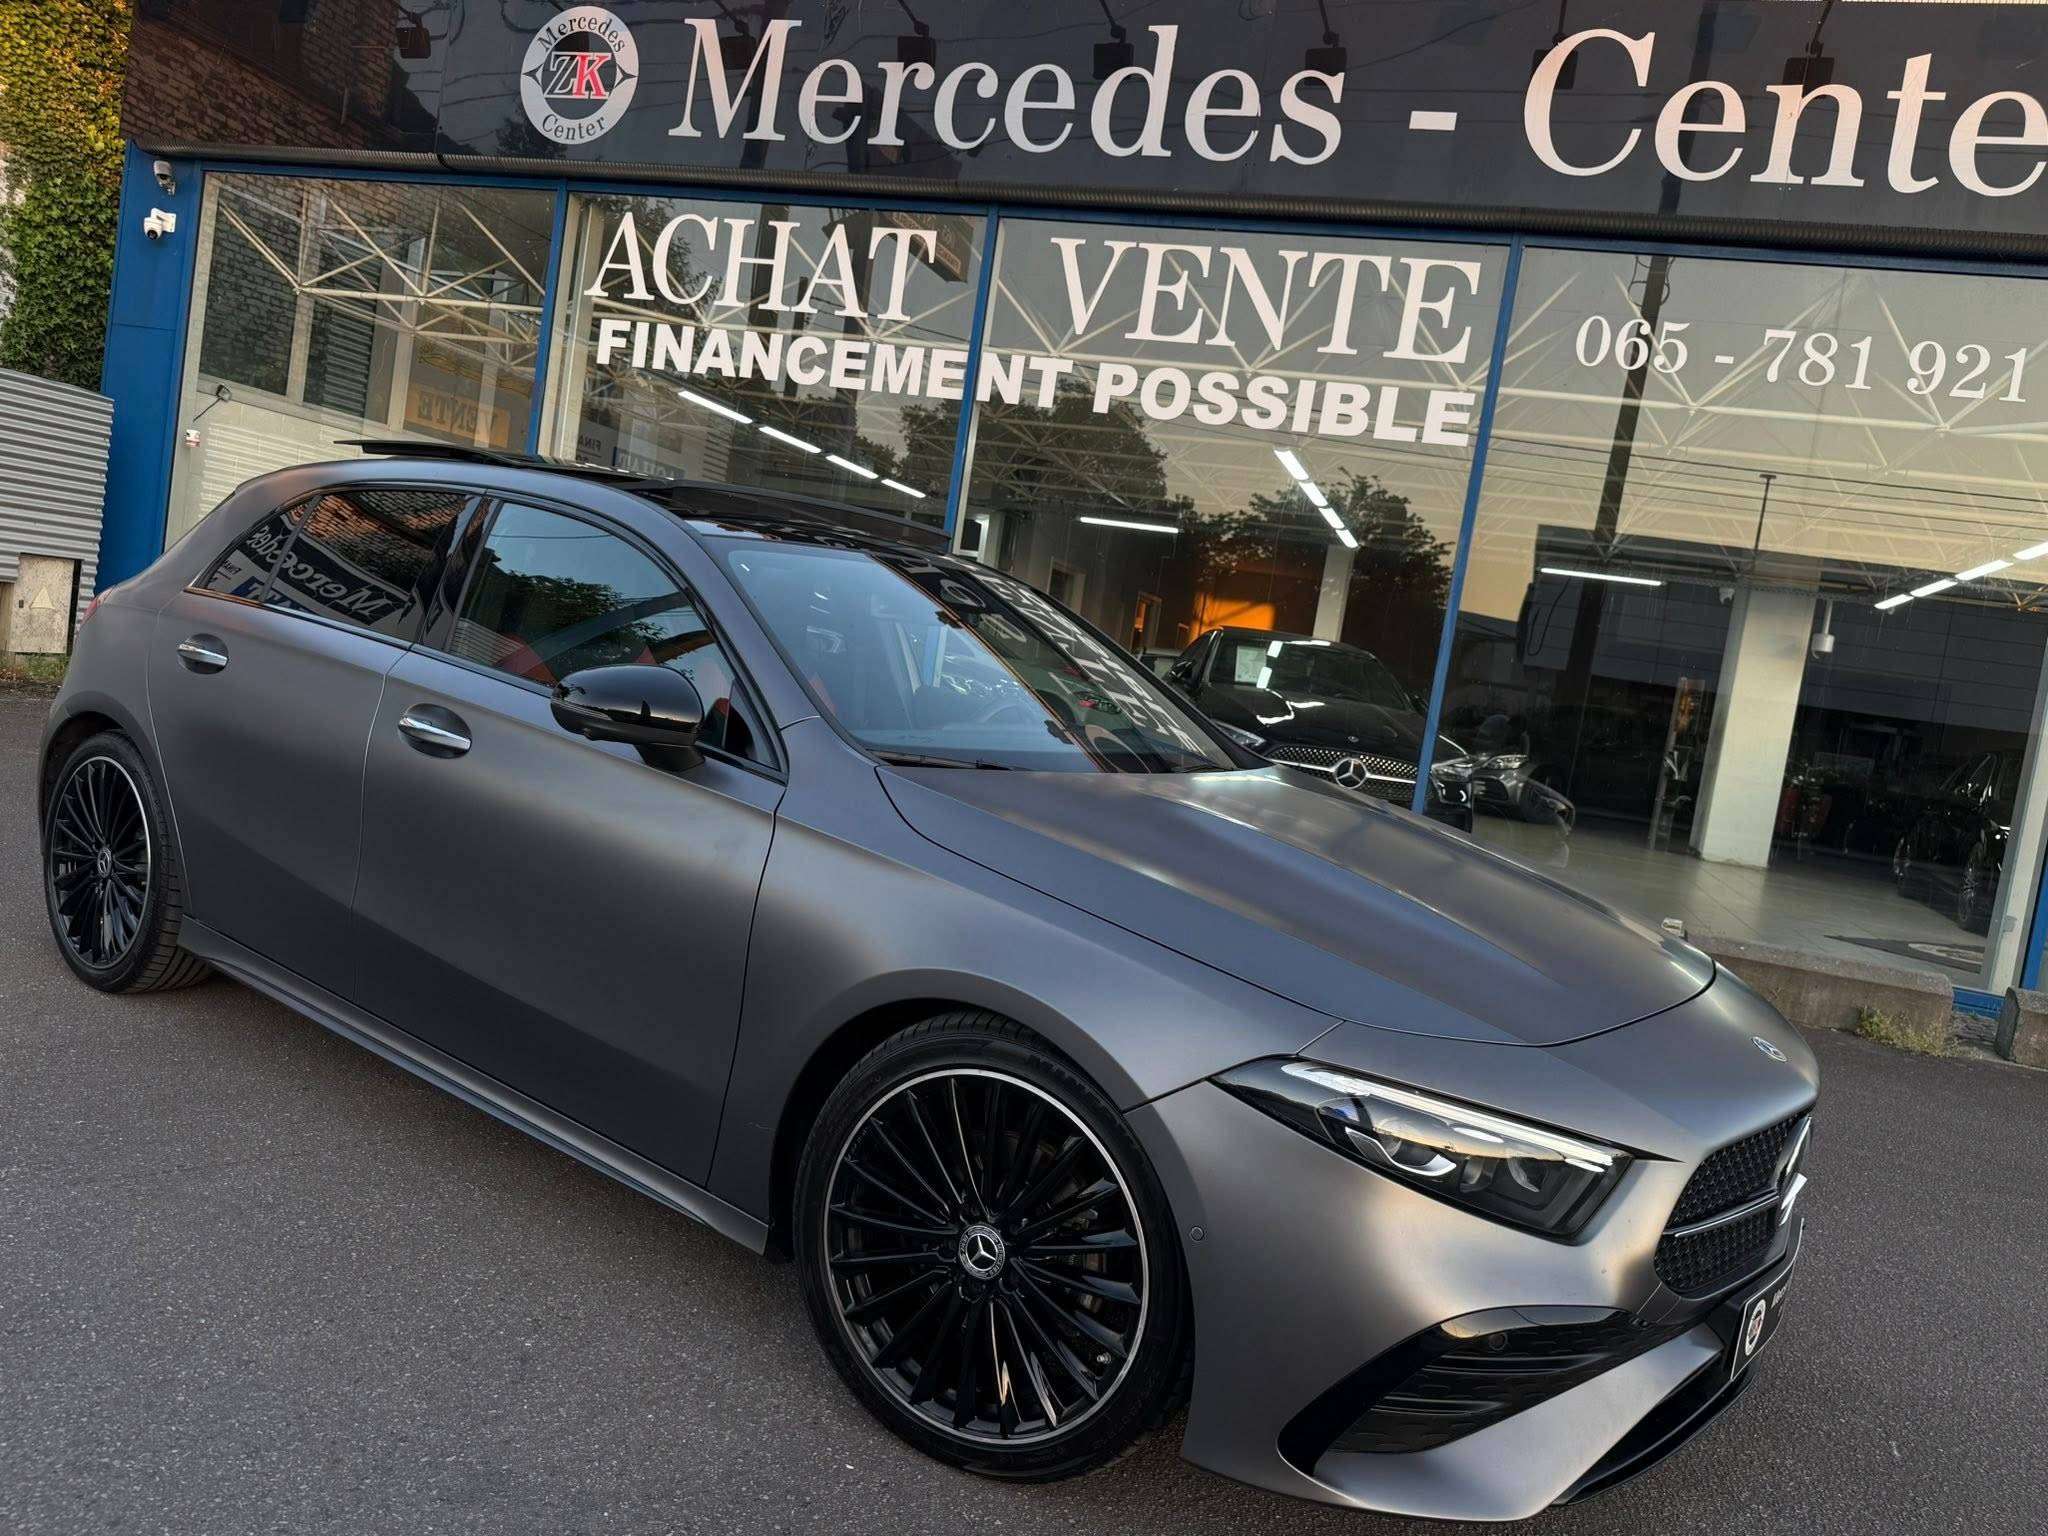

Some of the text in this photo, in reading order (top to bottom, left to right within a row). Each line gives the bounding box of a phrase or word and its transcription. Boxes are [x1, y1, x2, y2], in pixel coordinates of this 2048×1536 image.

[538, 16, 625, 52] Mercedes
[544, 51, 612, 99] ZK
[542, 113, 605, 141] Center
[668, 18, 1346, 166] Mercedes
[584, 212, 1481, 364] ACHAT VENTE
[597, 319, 1477, 447] FINANCEMENT POSSIBLE
[1576, 315, 1691, 373] 065
[1762, 328, 1875, 391] 781
[1906, 341, 2027, 403] 921
